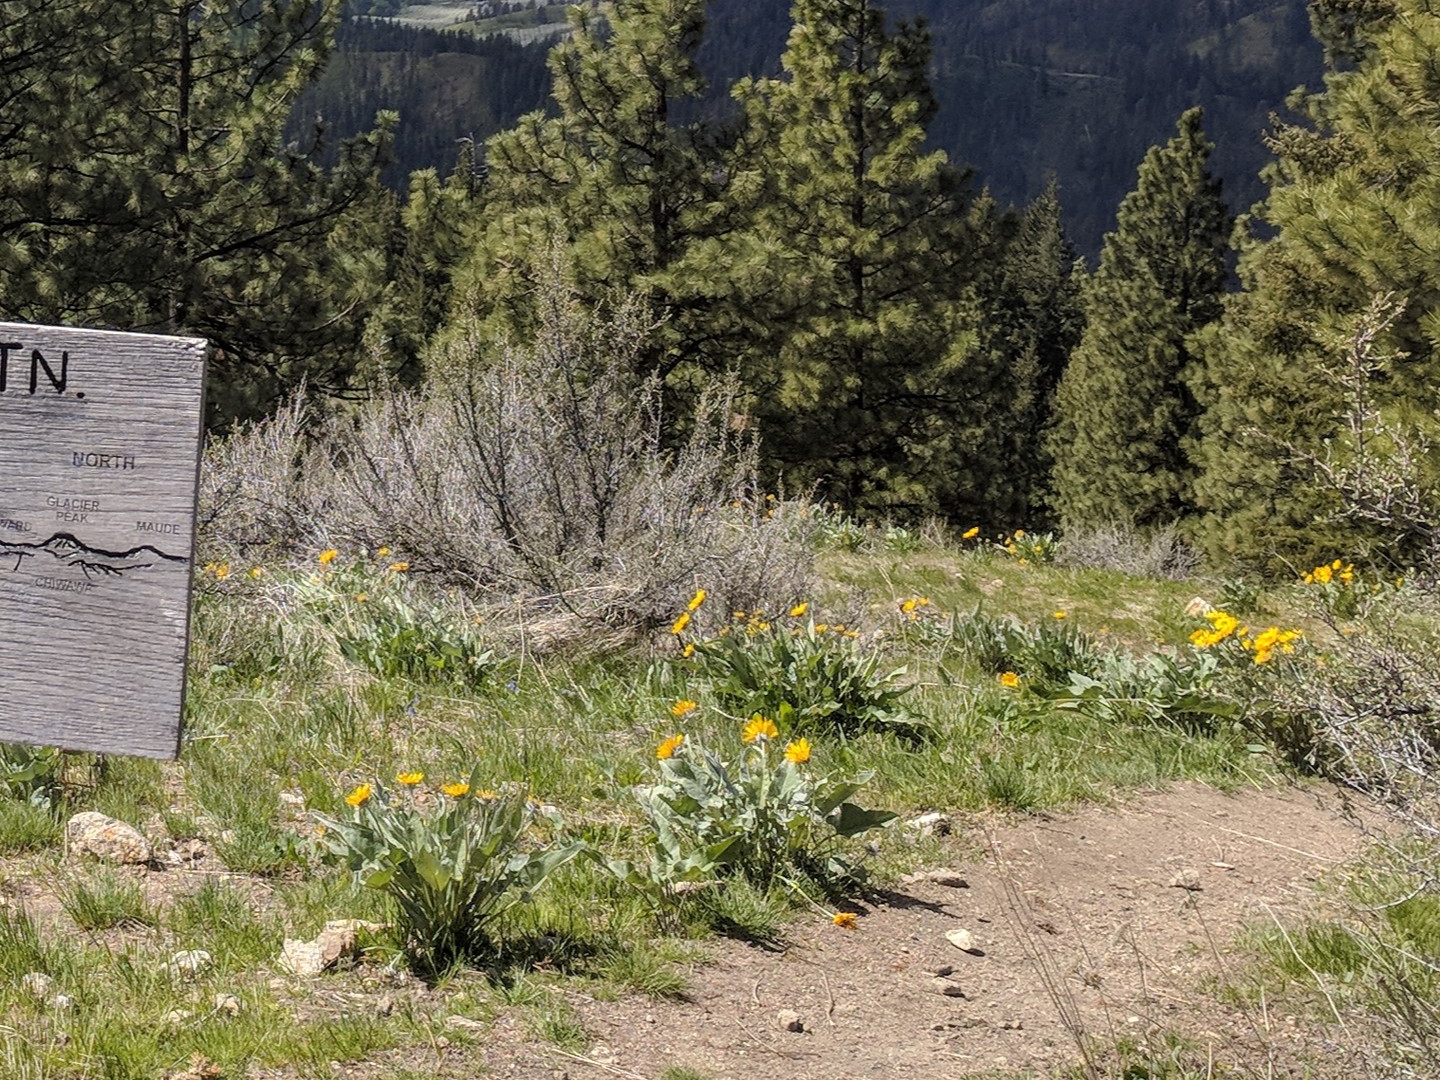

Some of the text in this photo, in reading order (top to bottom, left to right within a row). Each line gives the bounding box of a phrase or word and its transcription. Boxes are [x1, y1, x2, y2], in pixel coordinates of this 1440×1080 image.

[72, 451, 136, 470] NORTH
[46, 496, 100, 512] GLACIER
[56, 511, 89, 524] PEAK
[136, 521, 181, 535] MAUDE
